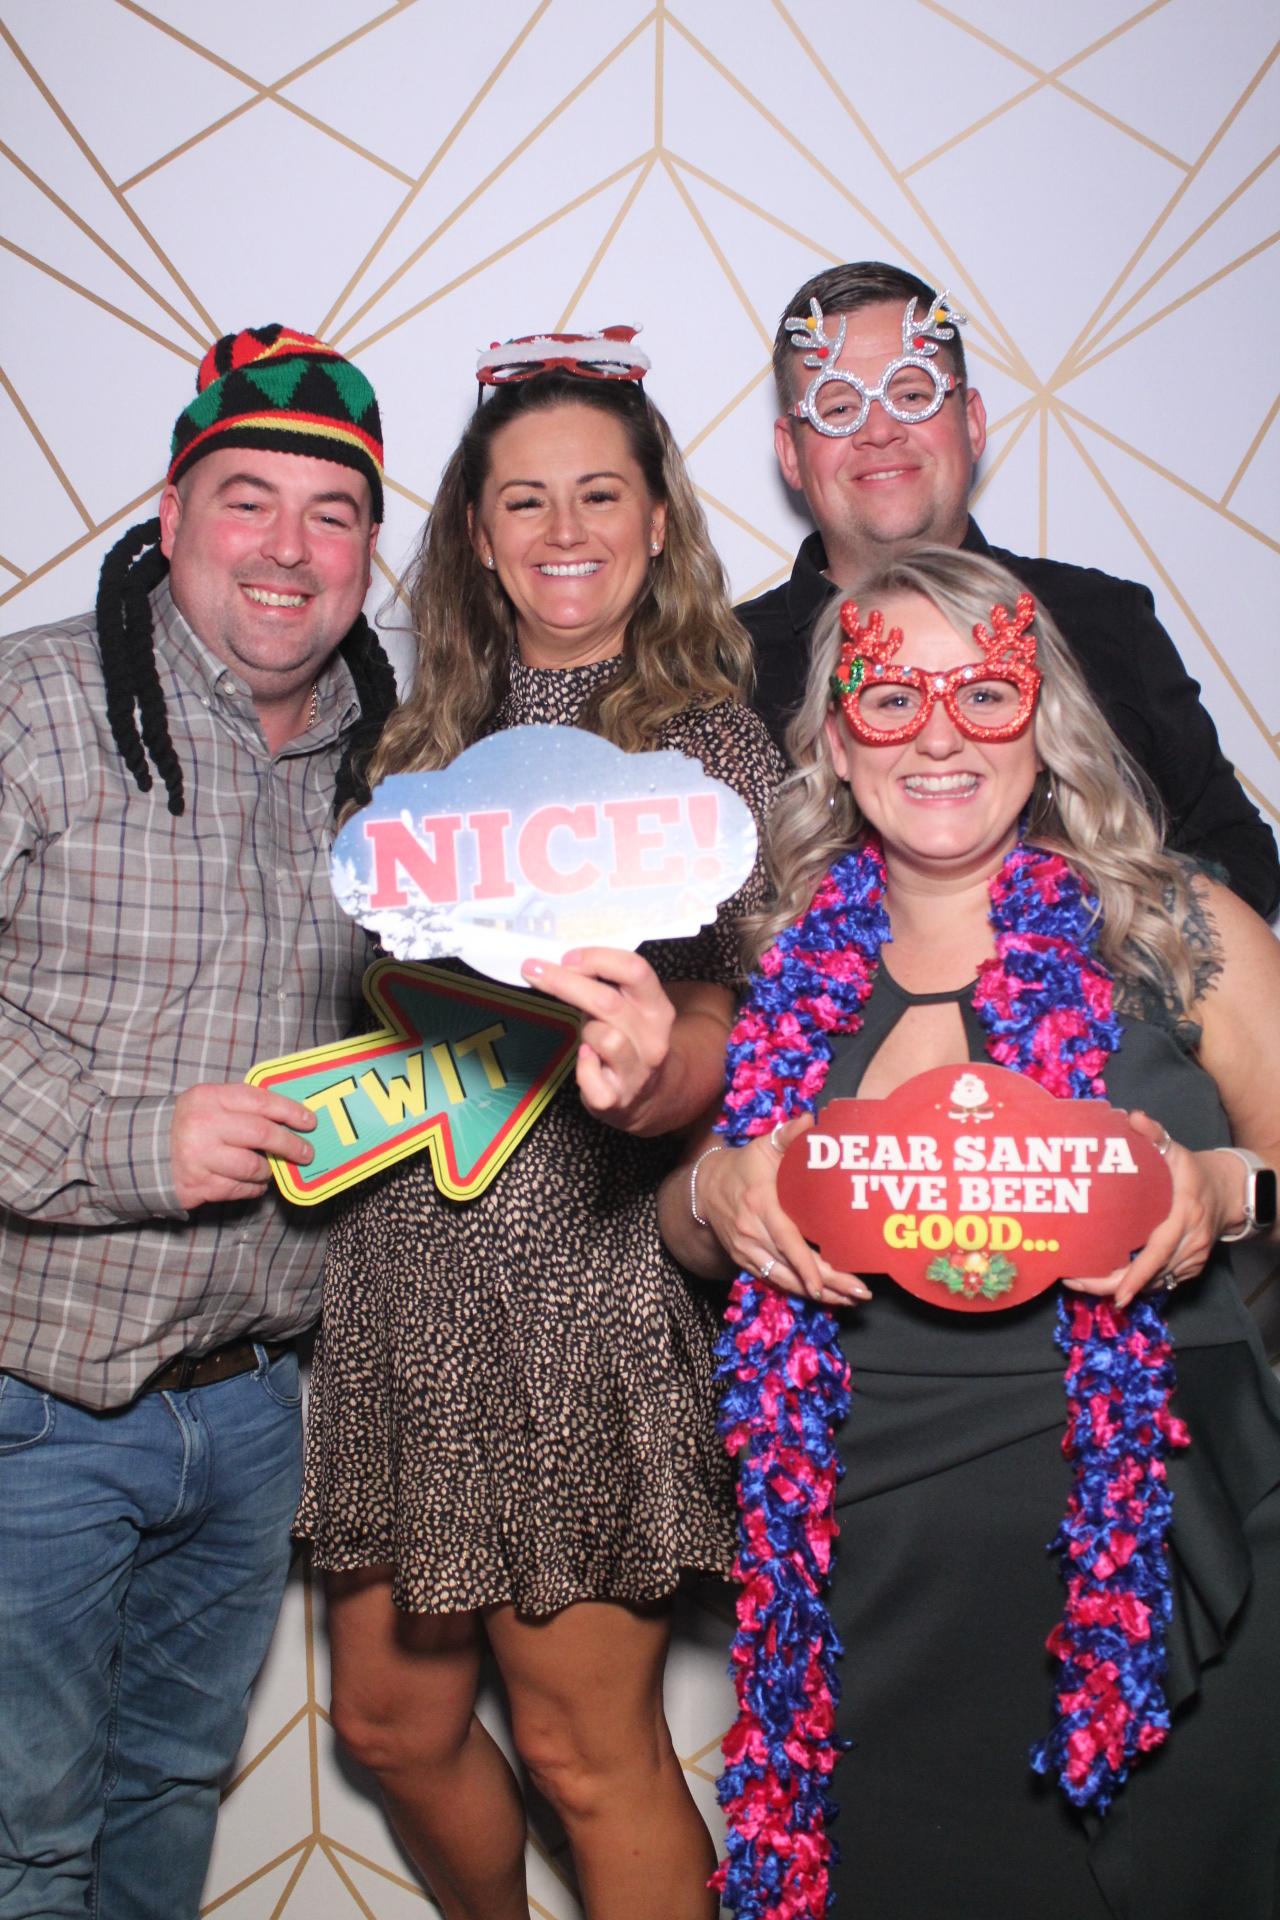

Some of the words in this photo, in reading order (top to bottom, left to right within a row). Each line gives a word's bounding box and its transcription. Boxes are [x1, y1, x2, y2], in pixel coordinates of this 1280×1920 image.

[363, 794, 719, 908] NICE!
[303, 1022, 508, 1146] TWIT
[806, 1134, 942, 1171] DEAR
[952, 1136, 1138, 1174] SANTA
[850, 1175, 947, 1211] I'VE
[958, 1177, 1092, 1213] BEEN
[883, 1214, 1059, 1252] GOOD...
